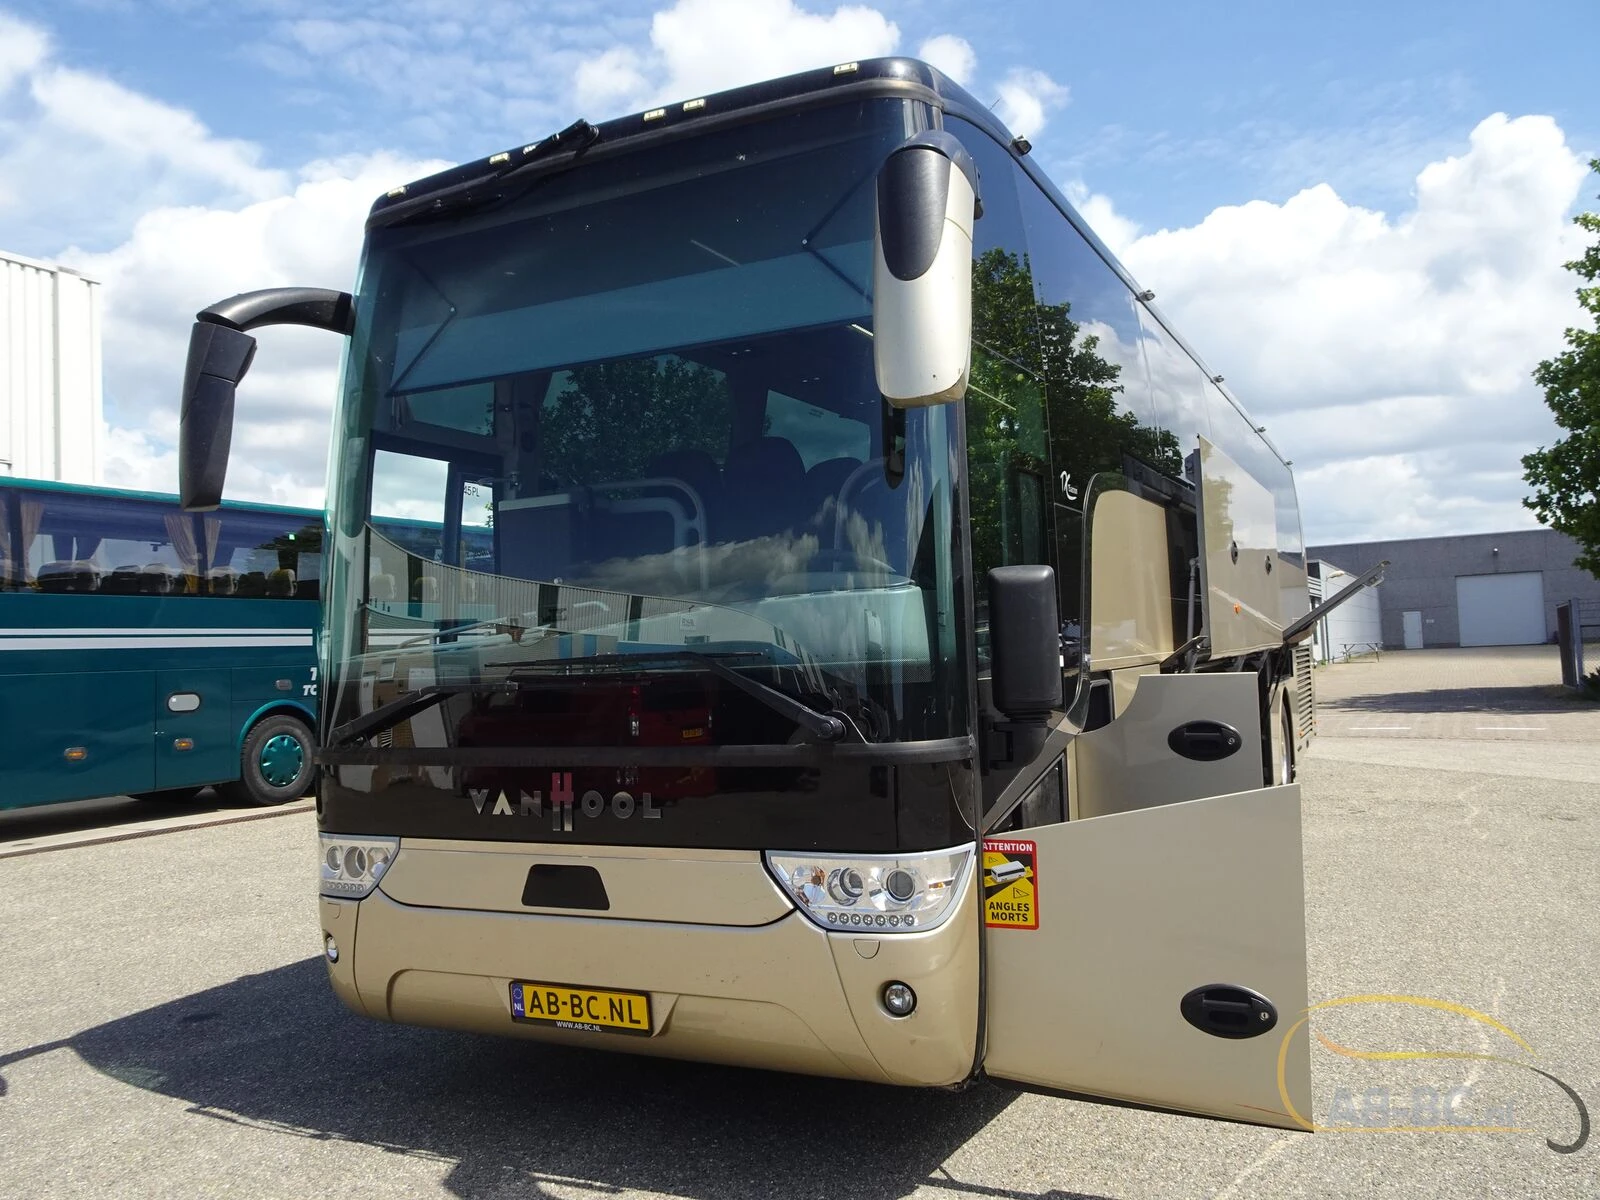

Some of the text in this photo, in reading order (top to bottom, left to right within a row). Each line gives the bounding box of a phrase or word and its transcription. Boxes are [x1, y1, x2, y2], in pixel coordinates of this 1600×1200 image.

[983, 842, 1033, 852] ATTENTION
[989, 902, 1030, 912] ANGLES
[991, 911, 1028, 922] MORTS
[514, 1002, 524, 1011] NL
[529, 990, 641, 1024] AB-BC.NL
[556, 1020, 602, 1032] WWW.AB-BC.NL
